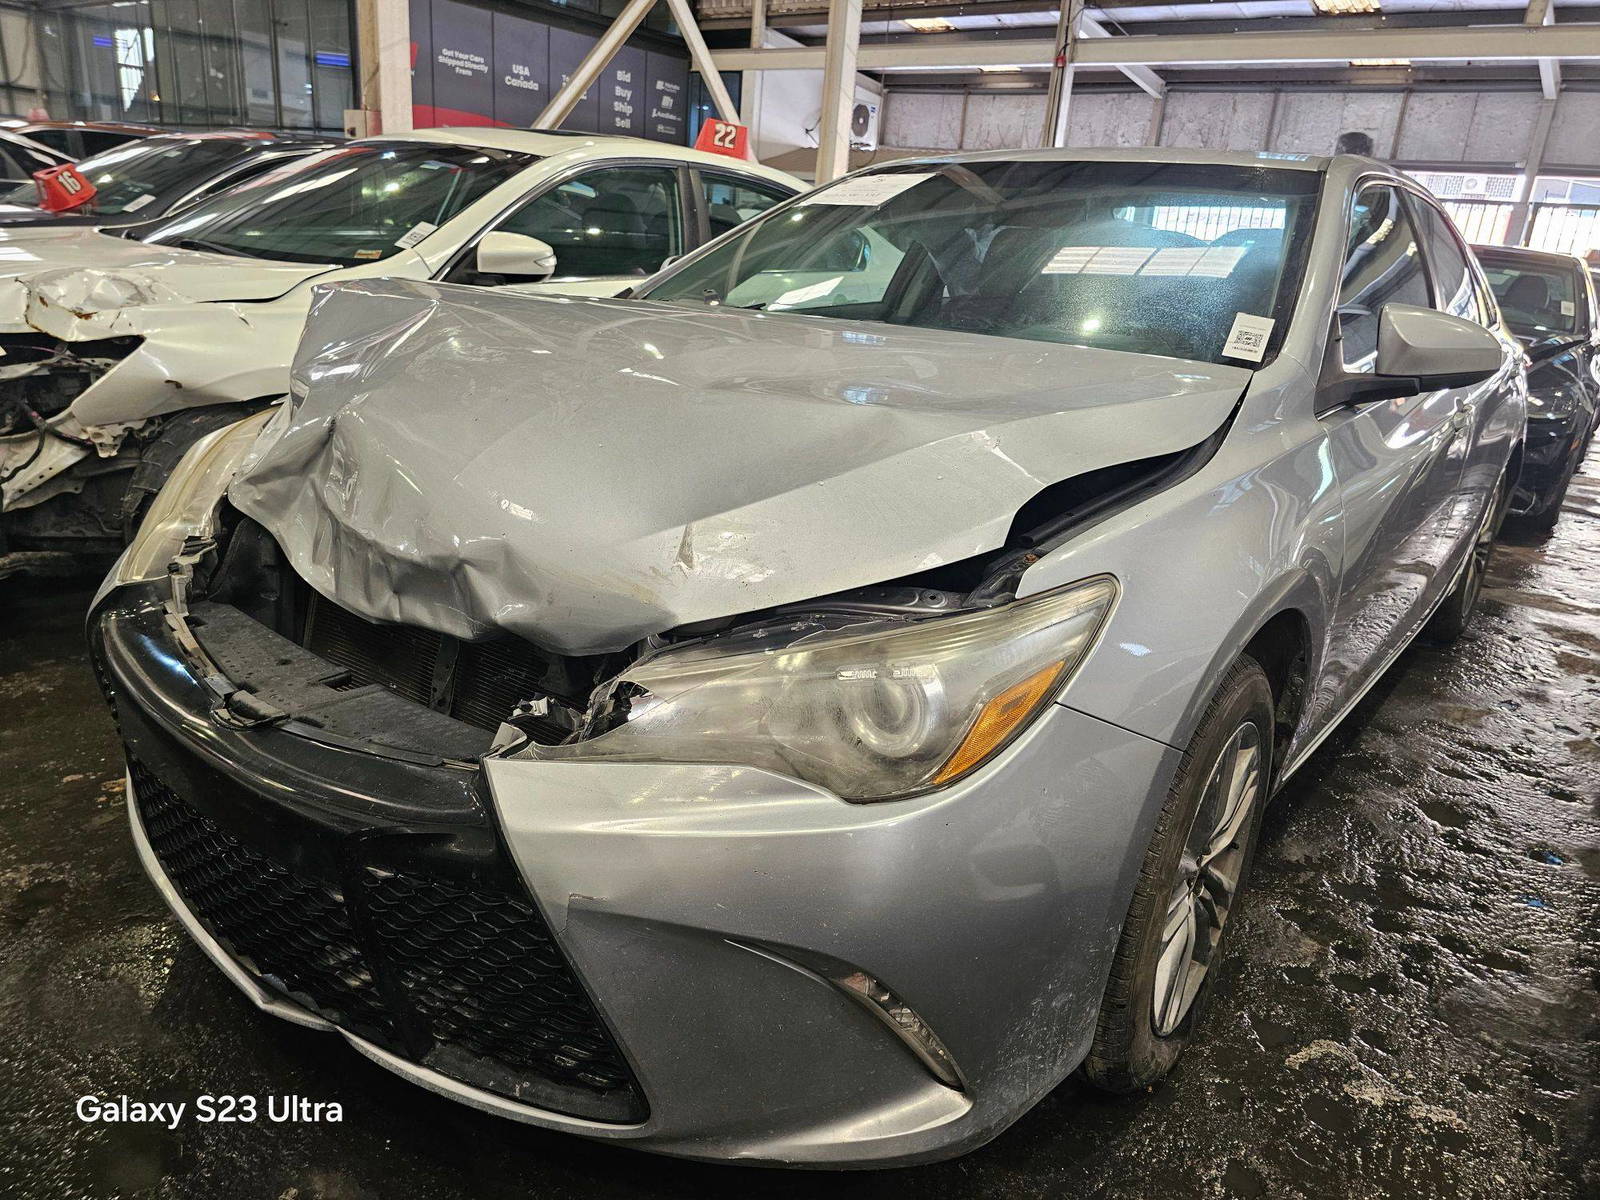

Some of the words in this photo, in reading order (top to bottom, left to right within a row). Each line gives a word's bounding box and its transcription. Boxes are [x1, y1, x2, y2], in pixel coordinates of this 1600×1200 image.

[454, 50, 469, 60] Your
[469, 54, 484, 63] Cars
[512, 64, 530, 76] USA
[616, 70, 631, 83] Bid
[504, 75, 539, 91] Canada
[615, 85, 632, 101] Buy
[614, 101, 633, 116] Ship
[615, 117, 631, 129] Sell
[713, 123, 737, 149] 22
[58, 171, 81, 195] 16
